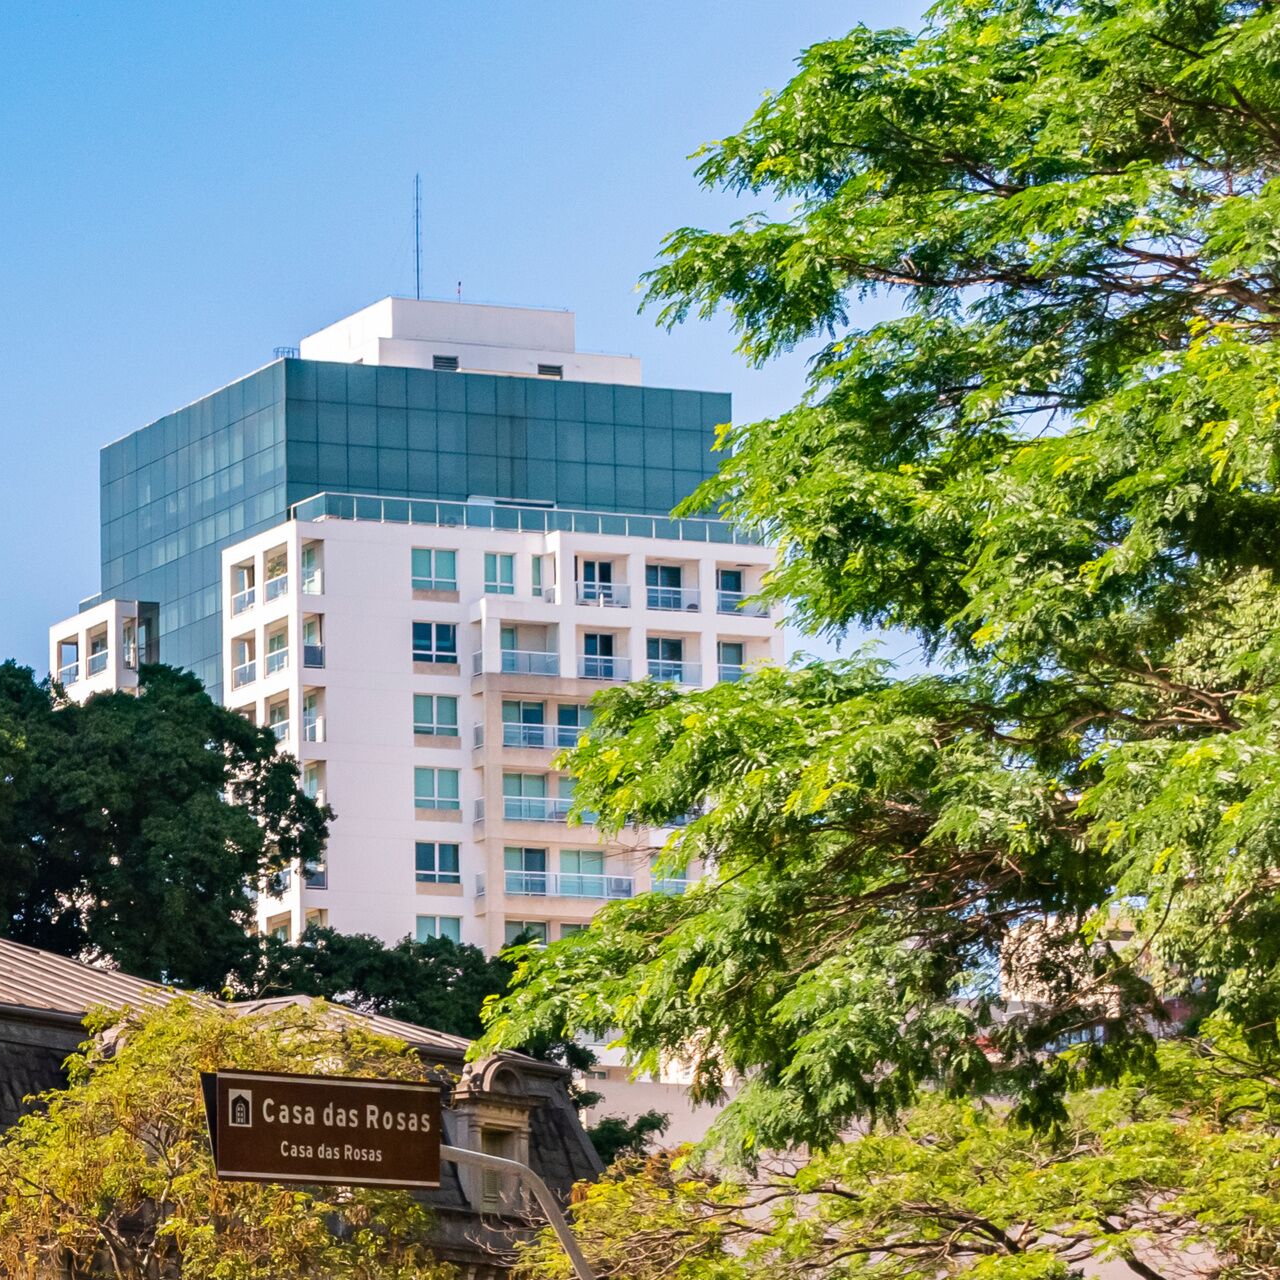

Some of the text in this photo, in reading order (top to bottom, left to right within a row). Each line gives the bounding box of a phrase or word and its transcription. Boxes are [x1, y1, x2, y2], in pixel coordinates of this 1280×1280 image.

[262, 1098, 431, 1133] Casa das Rosas
[280, 1141, 383, 1162] Casa das Rosas
